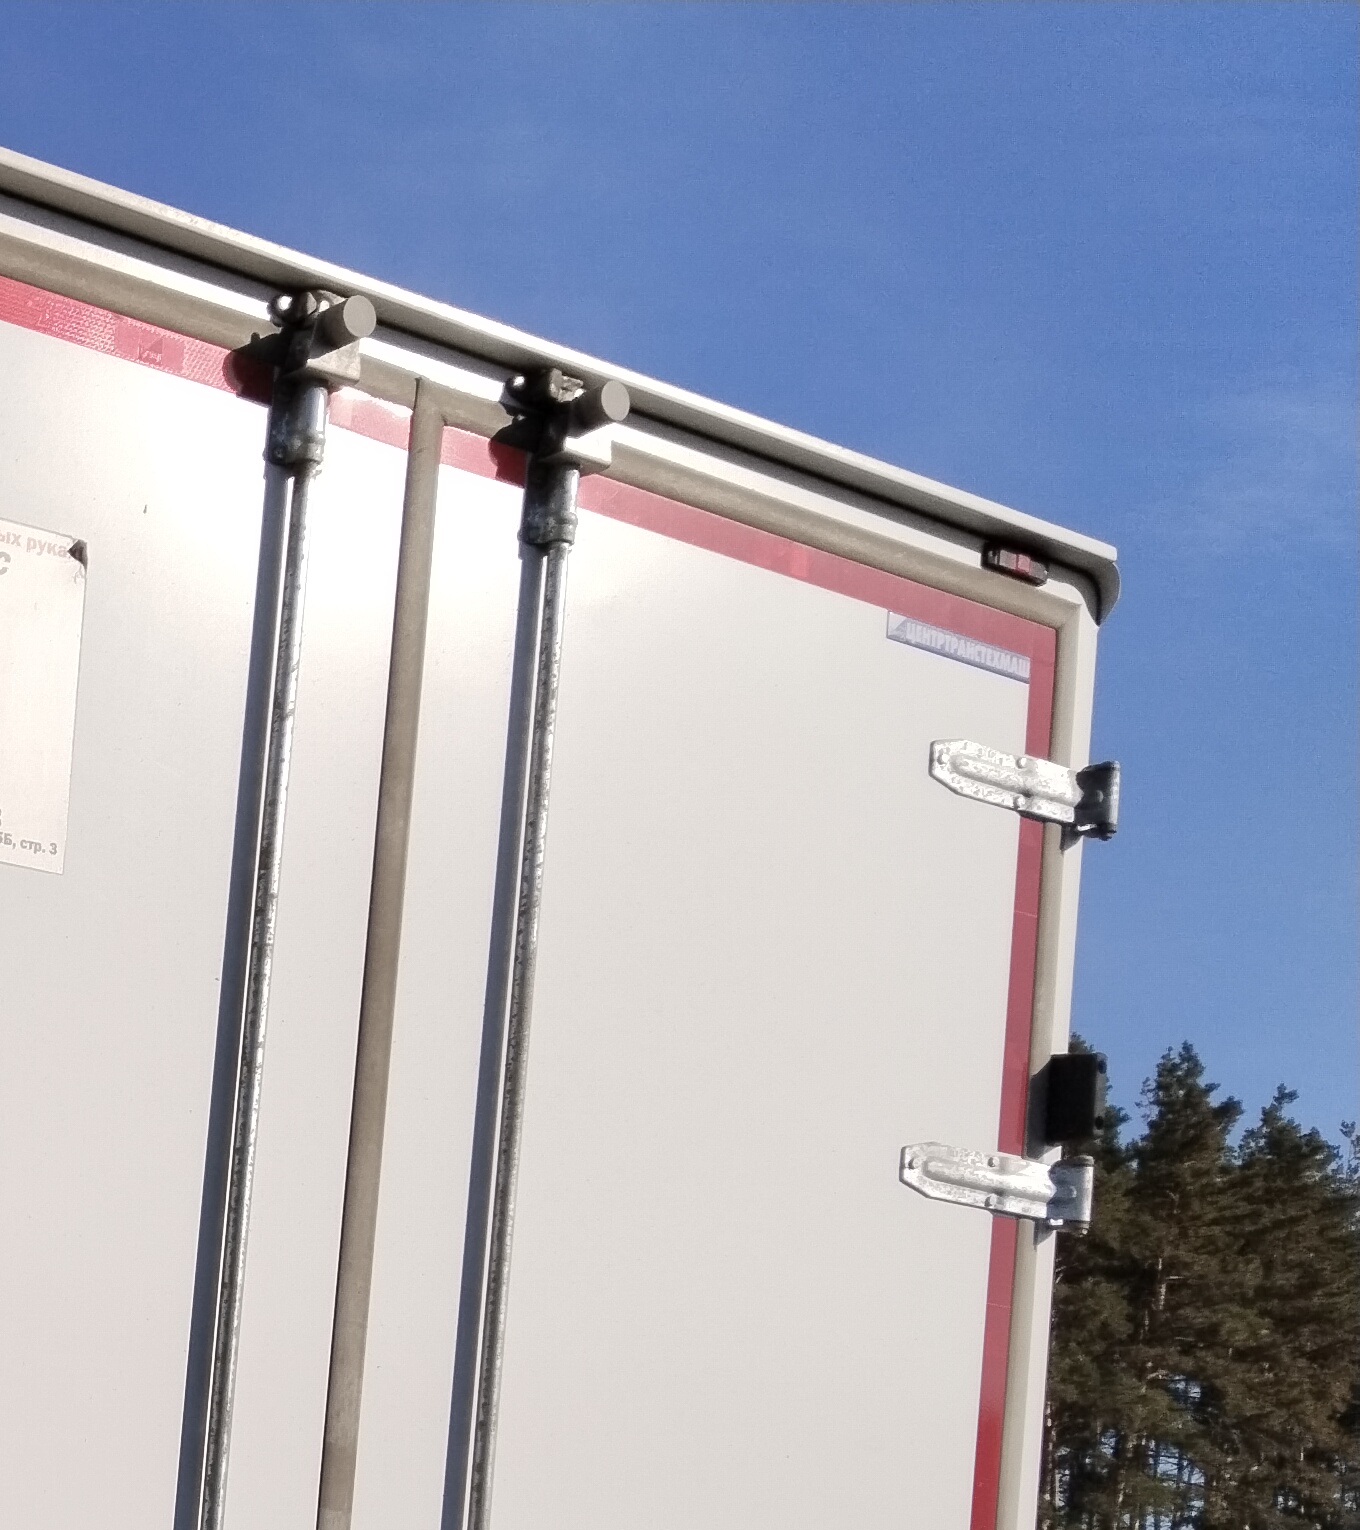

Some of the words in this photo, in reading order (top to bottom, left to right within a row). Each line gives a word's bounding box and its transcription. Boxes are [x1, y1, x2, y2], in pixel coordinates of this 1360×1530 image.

[26, 536, 80, 560] рука
[19, 838, 46, 854] стр.
[49, 842, 58, 856] 3
